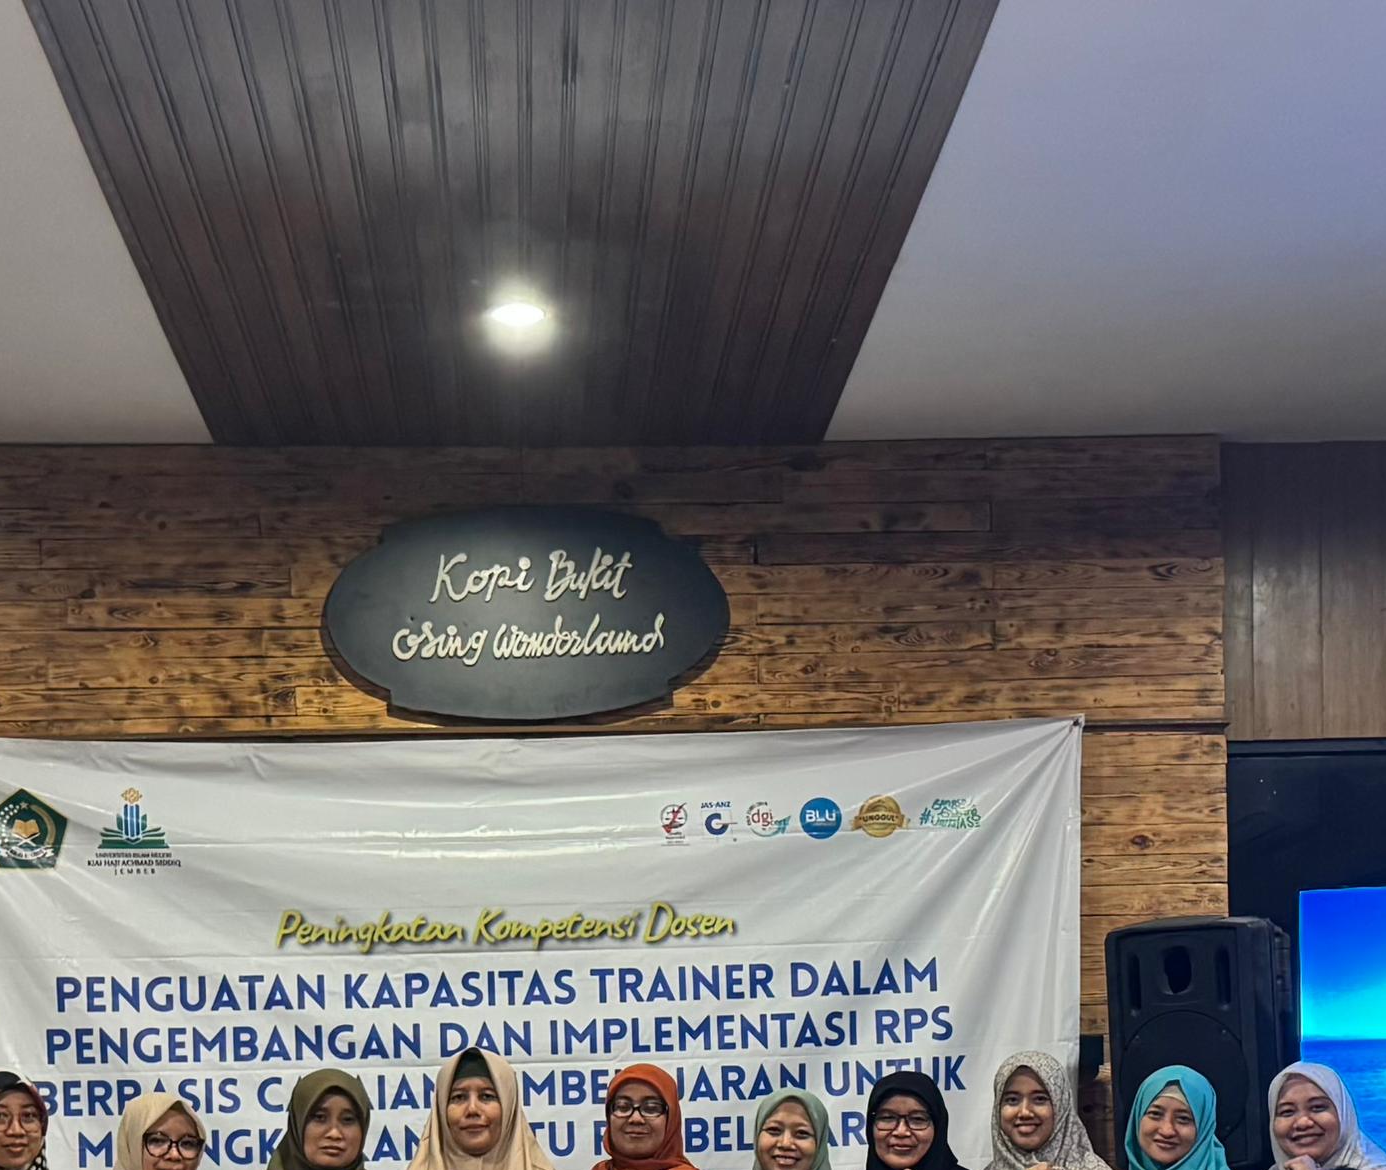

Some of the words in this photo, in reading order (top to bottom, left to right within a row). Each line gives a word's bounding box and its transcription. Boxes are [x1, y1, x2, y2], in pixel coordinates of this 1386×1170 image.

[429, 552, 535, 603] Kopi
[543, 546, 633, 602] Bukit
[805, 809, 837, 822] BLU
[275, 909, 465, 954] Peningkatan
[473, 908, 637, 950] Kompetensi
[643, 900, 737, 944] Dosen
[57, 976, 326, 1013] PENGUATAN
[344, 970, 576, 1009] KAPASITAS
[590, 963, 775, 1003] TRAINER
[790, 957, 939, 998] DALAM
[47, 1024, 422, 1065] PENGEMBANGAN
[439, 1021, 533, 1059] DAN
[550, 1011, 858, 1055] IMPLEMENTASI
[875, 1006, 954, 1045] RPS
